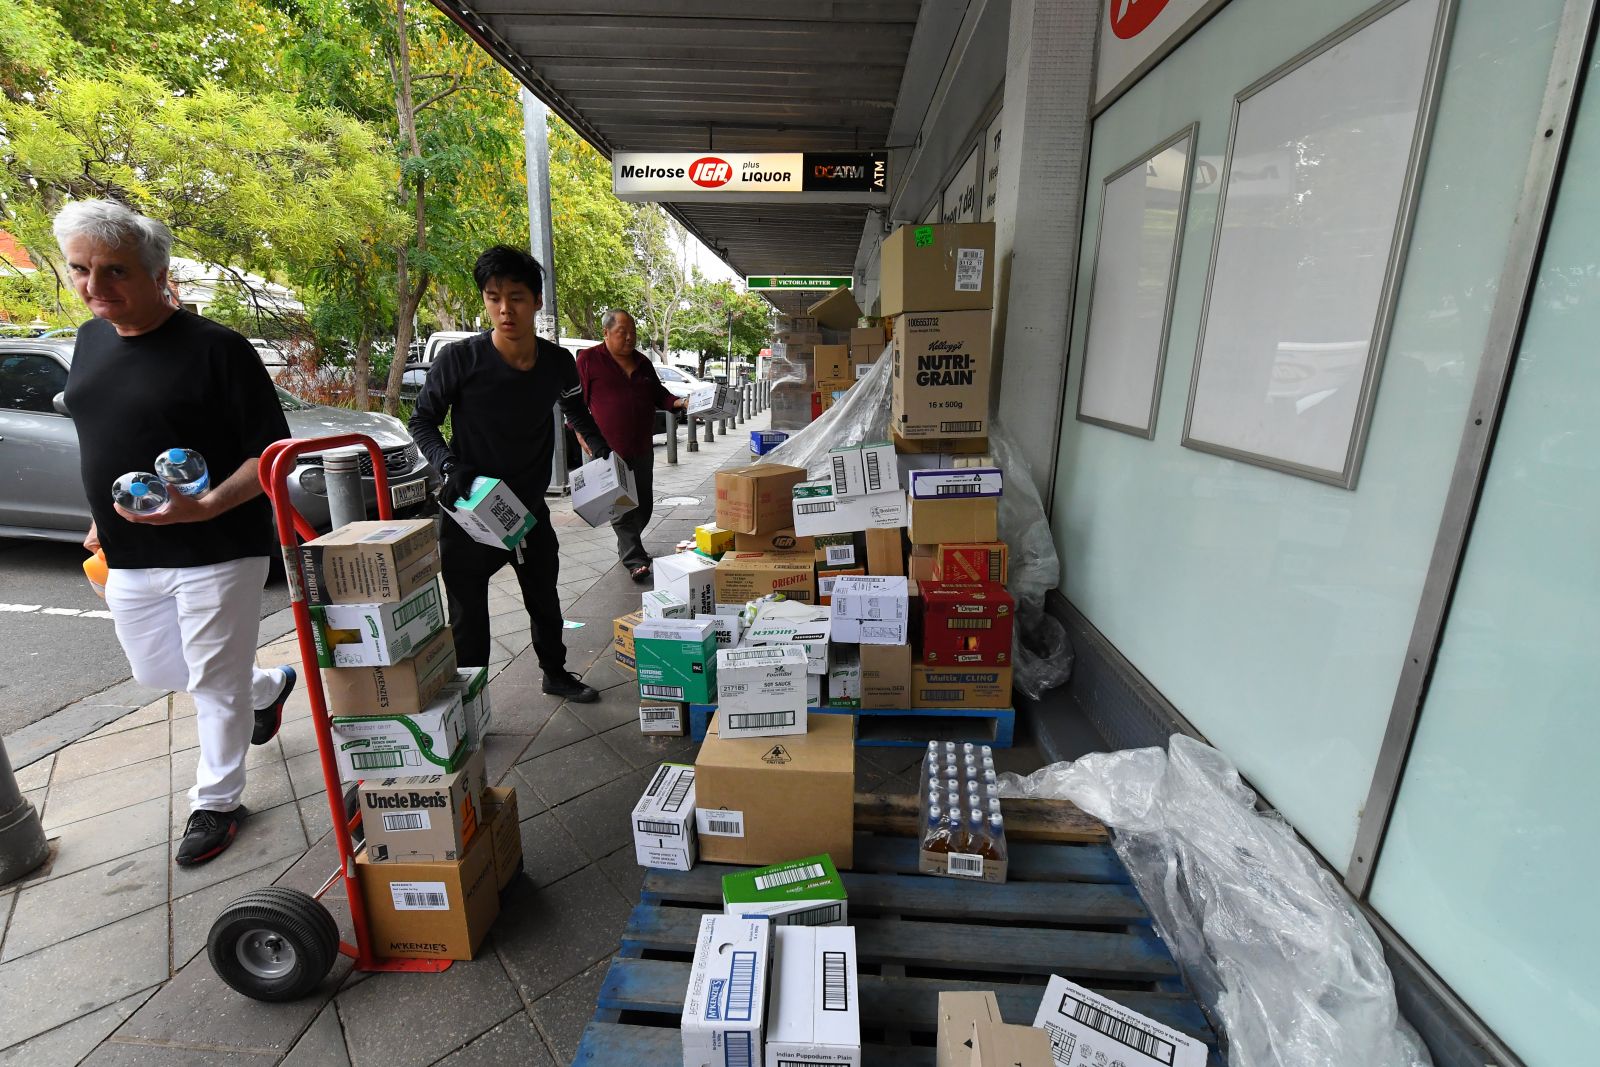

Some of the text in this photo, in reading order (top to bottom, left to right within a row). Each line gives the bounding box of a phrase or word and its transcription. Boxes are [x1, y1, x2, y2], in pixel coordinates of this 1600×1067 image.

[621, 163, 727, 182] Melrose IGA
[742, 161, 760, 169] plus
[742, 172, 791, 182] LIQUOR
[874, 161, 884, 187] ATM
[928, 341, 963, 353] Kellogg's
[918, 354, 975, 370] NUTRI-
[916, 370, 973, 386] GRAIN
[490, 499, 509, 517] RICE
[498, 508, 516, 527] NOW
[774, 538, 794, 546] IGA
[302, 550, 314, 571] PLANT
[772, 574, 808, 589] ORIENTAL
[966, 674, 993, 682] CLING
[366, 792, 447, 809] Uncle Ben's
[391, 942, 447, 952] McKENZIE'S
[708, 980, 722, 1018] McKENZIE'S
